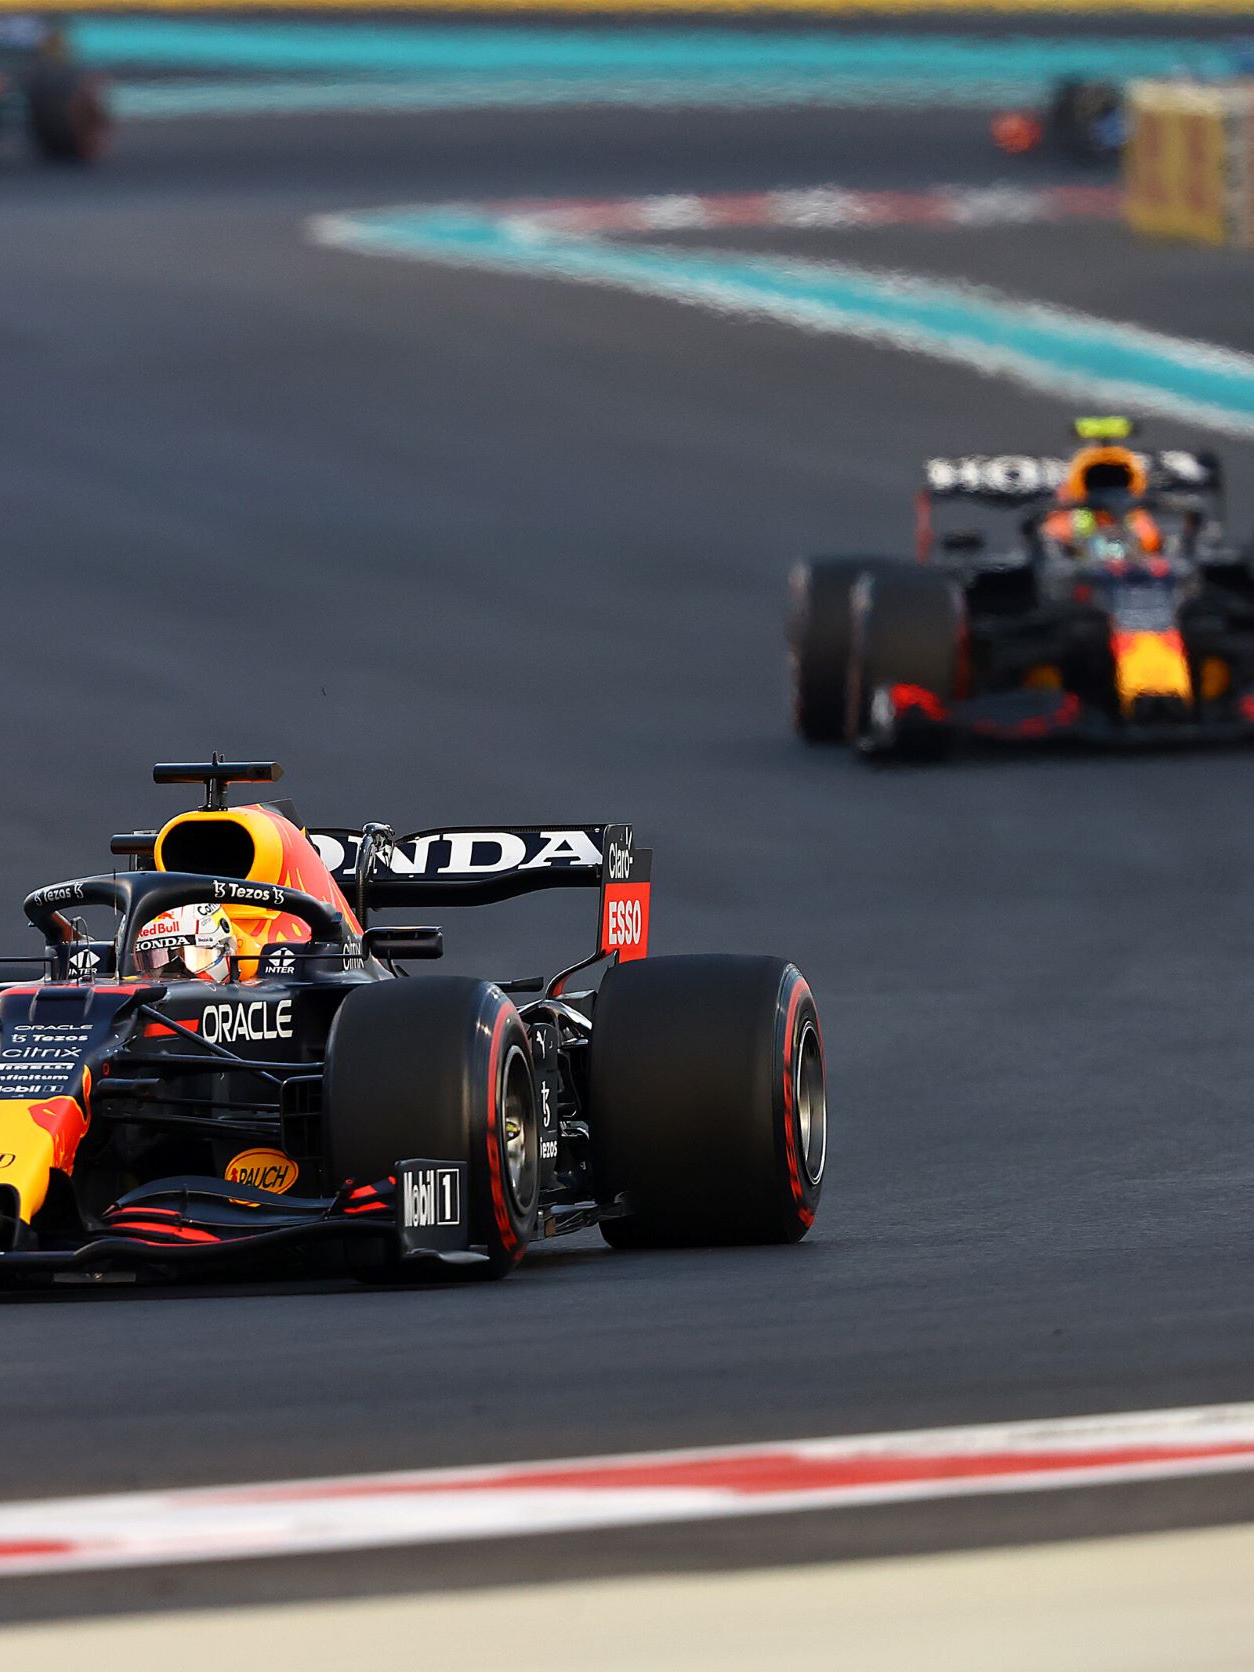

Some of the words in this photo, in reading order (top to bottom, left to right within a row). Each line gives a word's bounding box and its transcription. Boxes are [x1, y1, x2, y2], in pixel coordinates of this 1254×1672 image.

[310, 831, 603, 875] NDA
[608, 843, 631, 879] Claro
[228, 883, 270, 901] Tezos
[158, 921, 180, 934] Bull
[608, 900, 642, 945] ESSO
[265, 966, 295, 975] INTER
[202, 1000, 293, 1044] ORACLE
[32, 1034, 89, 1042] Tezos
[2, 1046, 82, 1058] citrix
[404, 1170, 435, 1227] Mobil
